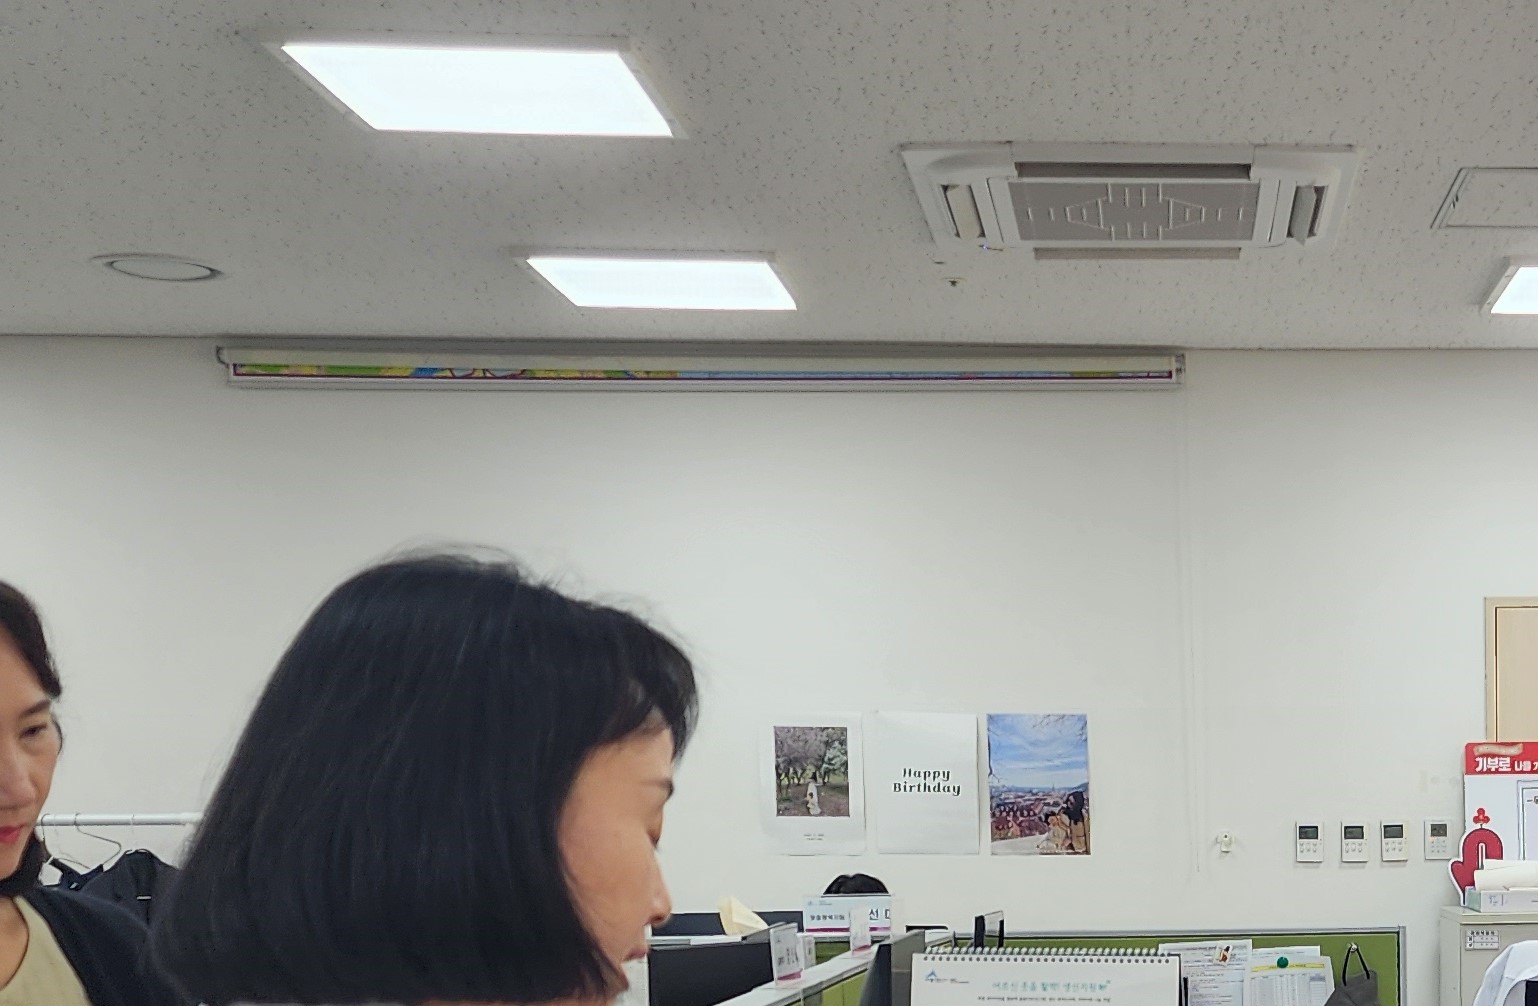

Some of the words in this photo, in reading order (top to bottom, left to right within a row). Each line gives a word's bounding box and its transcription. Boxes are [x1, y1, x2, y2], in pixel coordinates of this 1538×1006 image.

[1475, 756, 1511, 772] 기부로
[903, 768, 950, 782] Happy
[893, 780, 961, 797] Birthday
